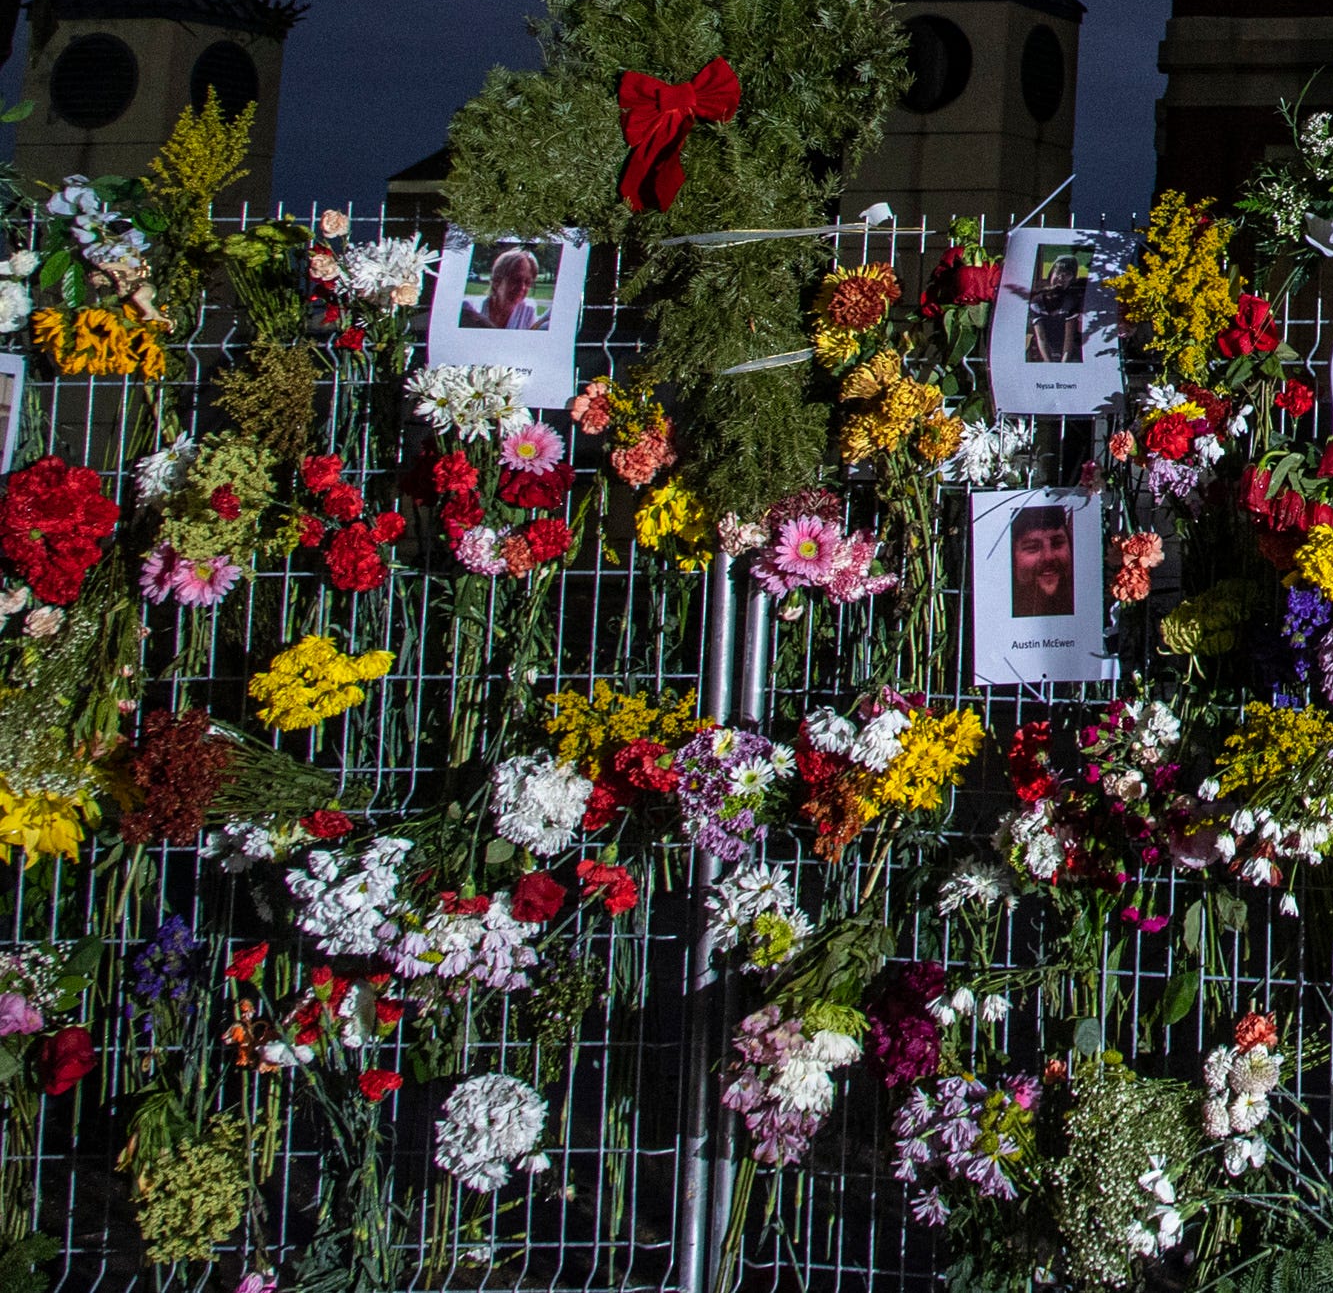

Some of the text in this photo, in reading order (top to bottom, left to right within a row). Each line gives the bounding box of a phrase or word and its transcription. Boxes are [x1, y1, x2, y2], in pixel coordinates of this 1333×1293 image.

[1036, 382, 1054, 390] Nyssa
[1011, 638, 1075, 650] Austin McEwen
